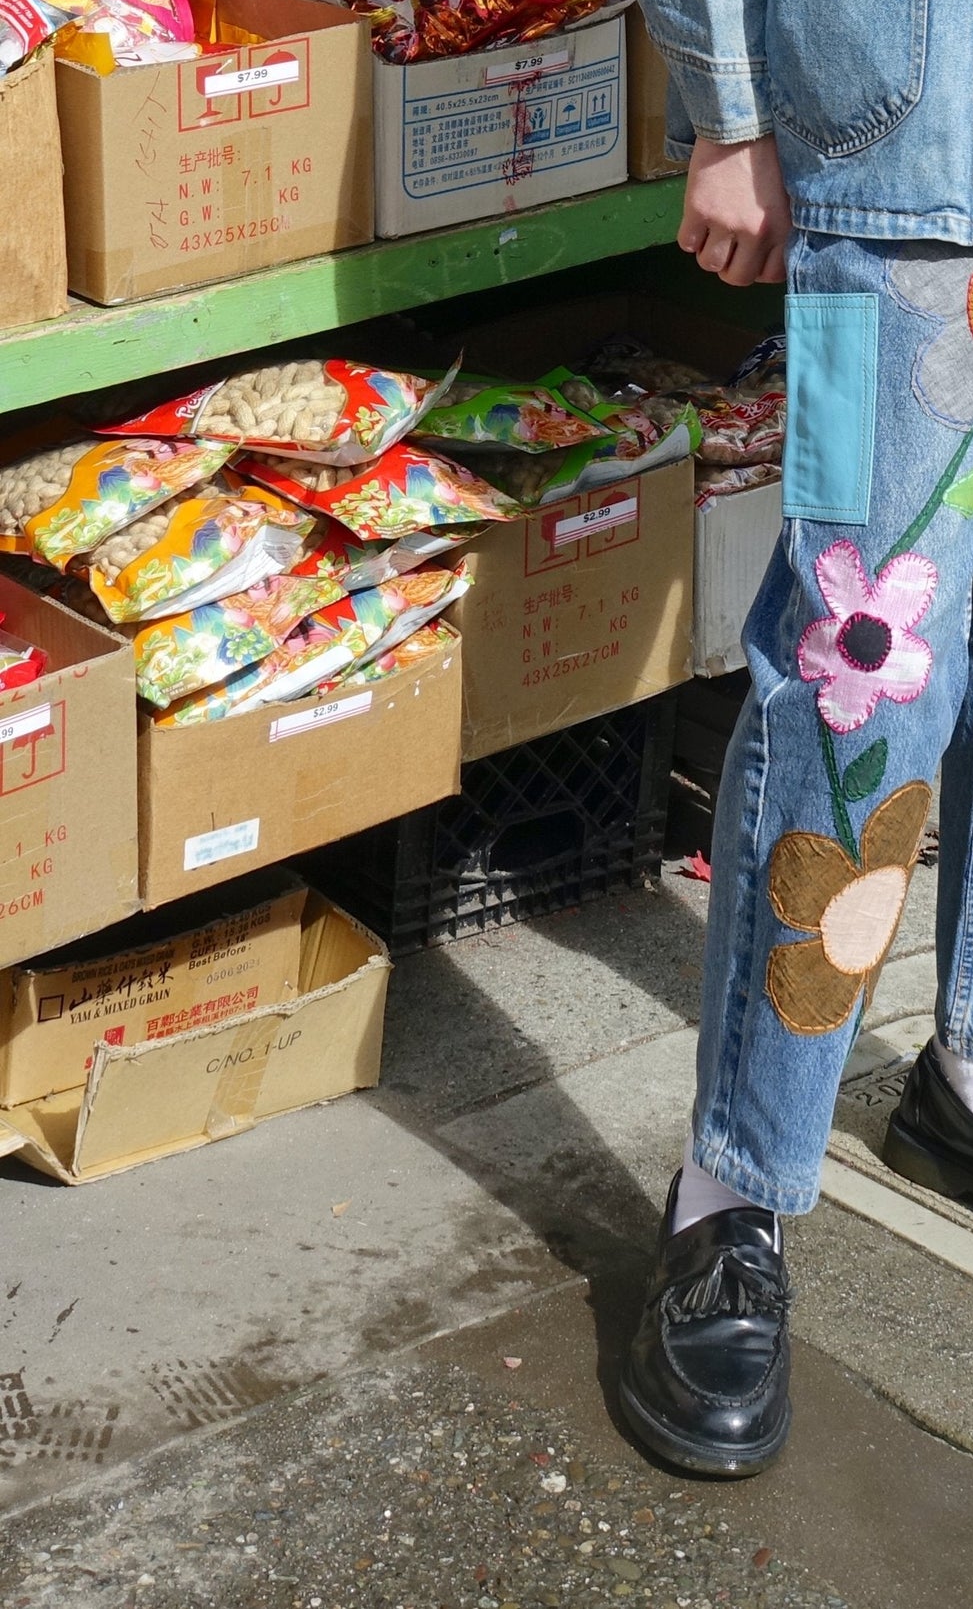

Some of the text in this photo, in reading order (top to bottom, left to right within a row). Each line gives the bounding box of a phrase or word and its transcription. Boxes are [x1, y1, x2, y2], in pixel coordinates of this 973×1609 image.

[514, 56, 543, 71] $7.99
[237, 69, 268, 83] $7.99
[179, 145, 241, 175] 生产批号:
[291, 158, 312, 175] KG
[279, 187, 299, 204] KG
[179, 215, 291, 252] 43X25X25CM
[583, 507, 611, 523] $2.99
[621, 586, 640, 606] KG
[609, 615, 628, 634] KG
[521, 641, 620, 688] 43X25X27CM
[312, 703, 339, 718] $2.99
[45, 824, 67, 846] KG
[30, 860, 53, 881] KG
[188, 945, 247, 971] Best Before
[70, 1010, 91, 1025] YAM
[104, 996, 137, 1016] MIXED
[139, 986, 171, 1006] GRAIN
[206, 1031, 302, 1073] C/NO. 1-UP
